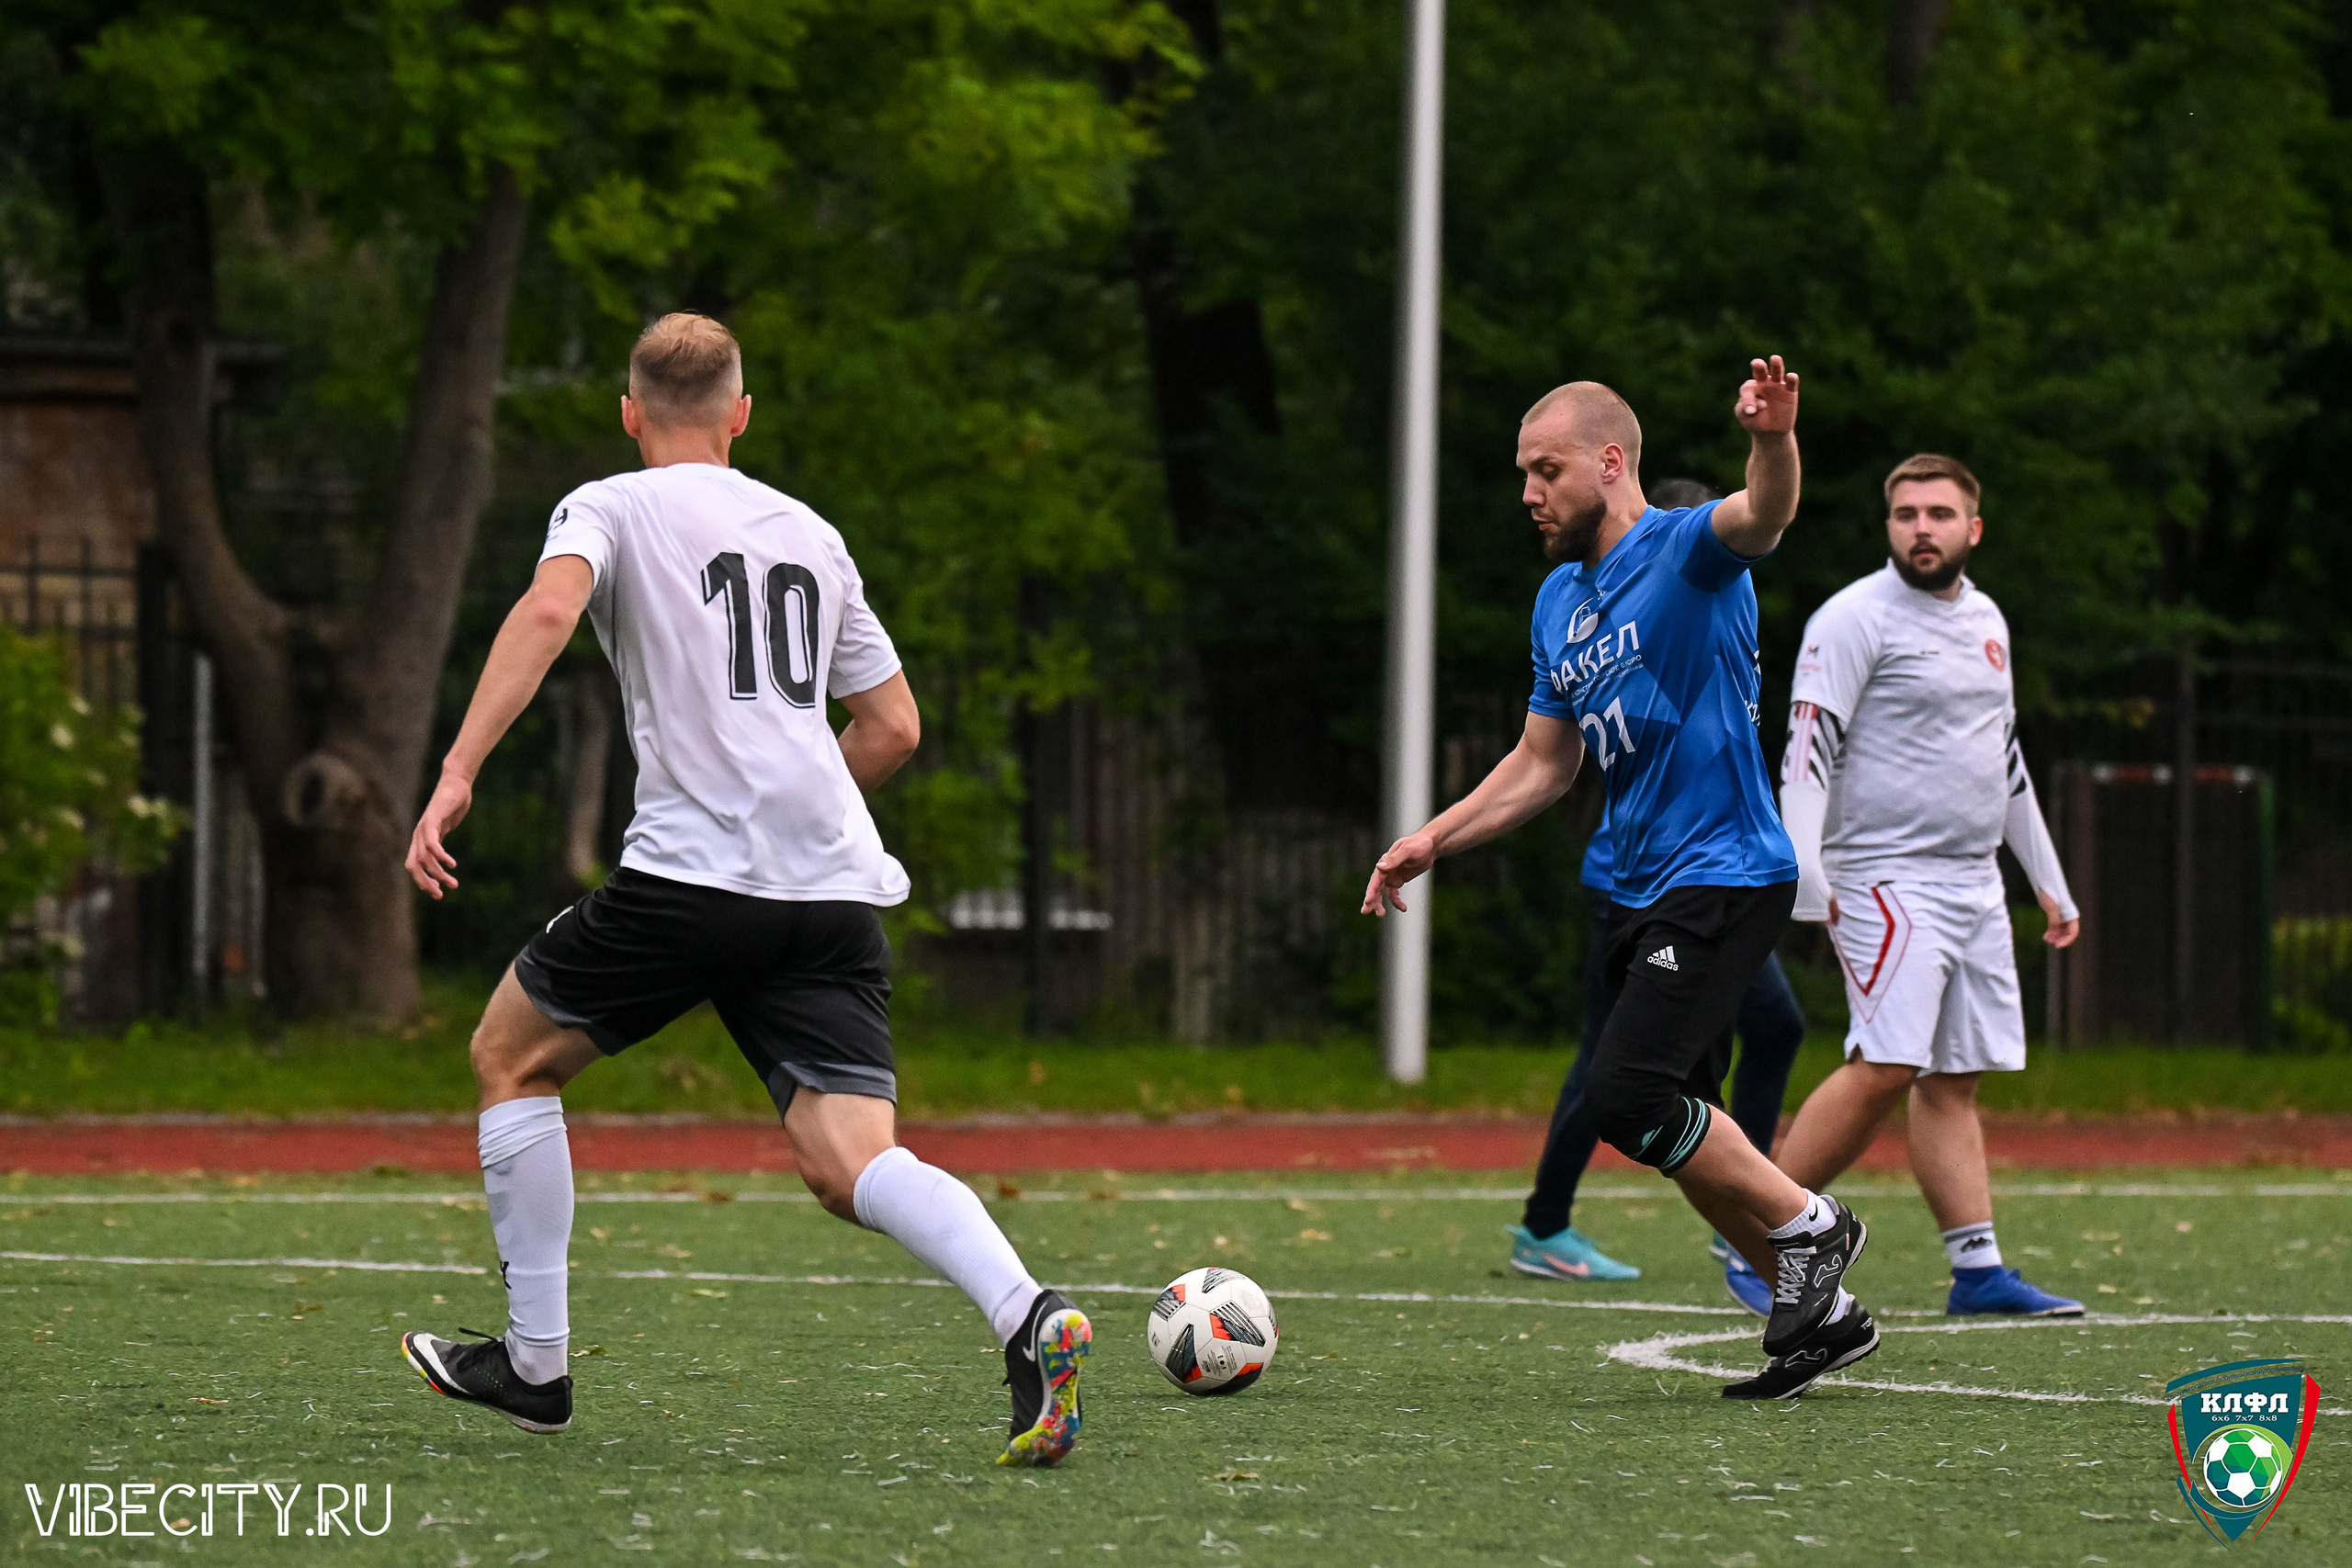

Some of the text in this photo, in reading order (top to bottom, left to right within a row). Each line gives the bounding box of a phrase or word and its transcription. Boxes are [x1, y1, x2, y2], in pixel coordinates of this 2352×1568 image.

[700, 551, 820, 709] 10
[1578, 696, 1636, 772] 21
[1647, 956, 1679, 971] adidas
